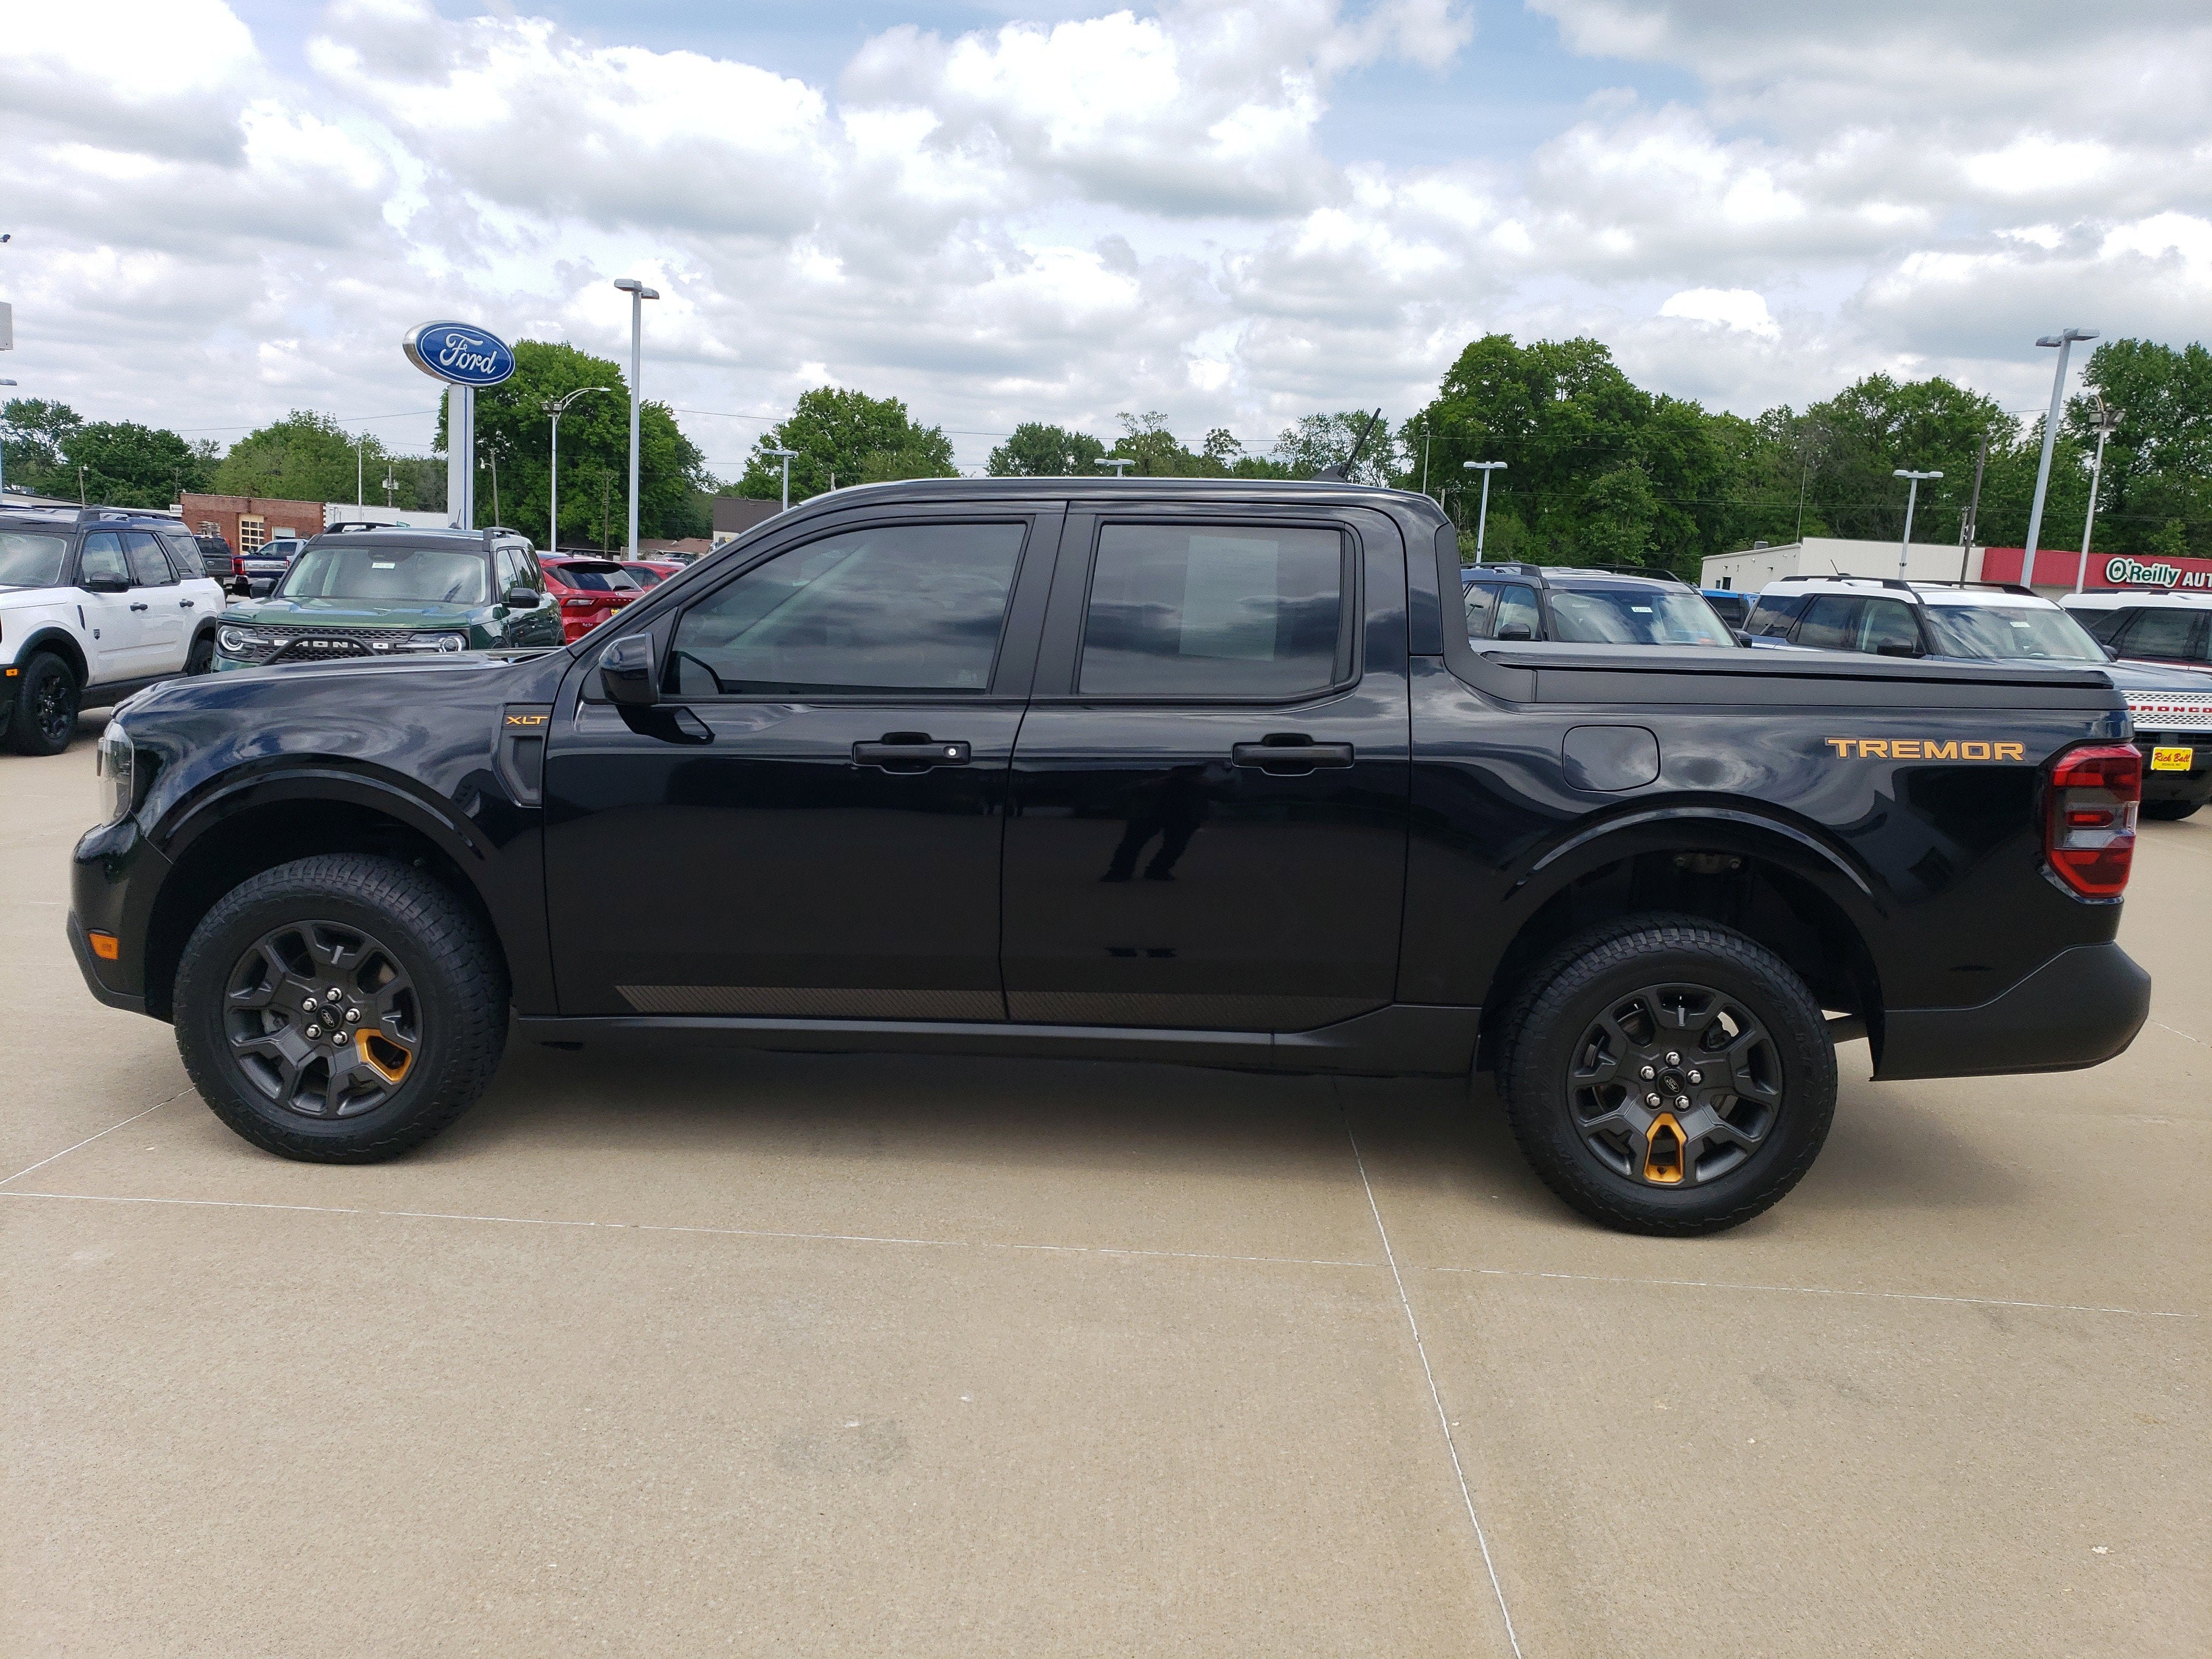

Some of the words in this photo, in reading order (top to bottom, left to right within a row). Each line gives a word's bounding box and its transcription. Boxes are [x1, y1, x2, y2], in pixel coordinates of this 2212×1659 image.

[439, 333, 498, 375] Ford
[2108, 558, 2180, 587] O'Reilly
[506, 716, 548, 725] XLT
[1827, 739, 2025, 761] TREMOR
